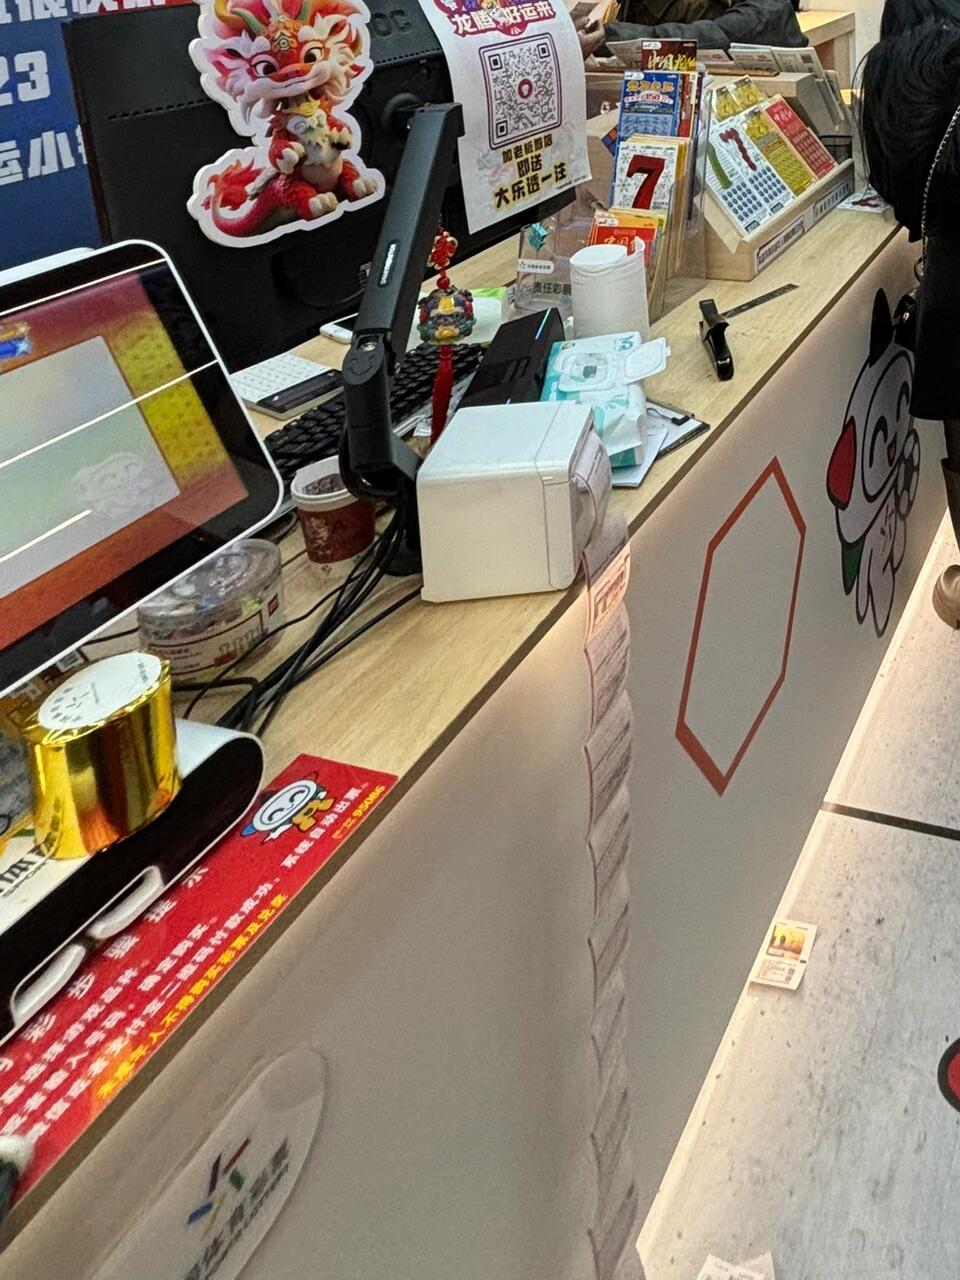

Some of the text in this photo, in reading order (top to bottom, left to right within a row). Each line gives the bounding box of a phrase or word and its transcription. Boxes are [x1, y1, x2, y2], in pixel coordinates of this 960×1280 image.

[495, 162, 567, 208] 大乐透一注
[626, 154, 666, 210] 7
